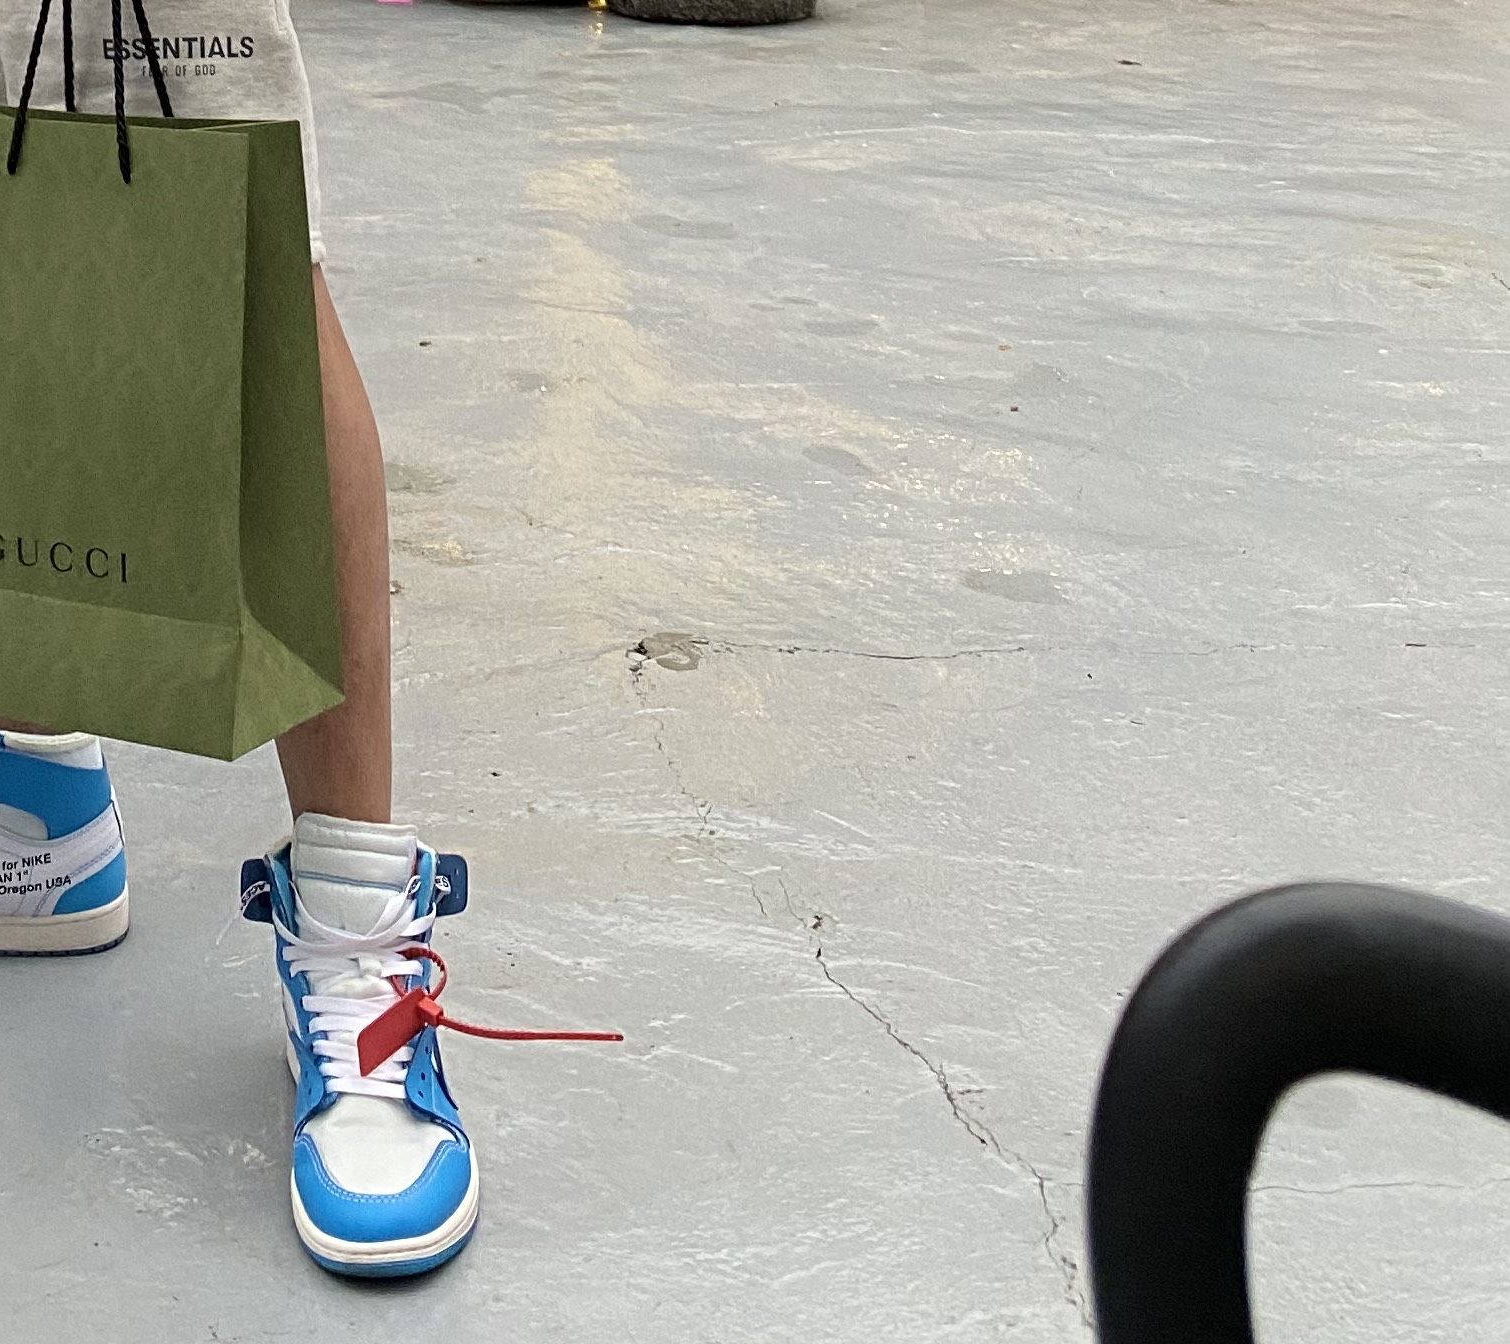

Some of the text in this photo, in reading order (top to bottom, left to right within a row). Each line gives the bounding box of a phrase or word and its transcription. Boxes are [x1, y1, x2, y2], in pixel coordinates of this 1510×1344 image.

[175, 64, 188, 77] OF
[194, 63, 217, 76] GOD
[2, 860, 19, 871] for
[21, 853, 52, 868] NIKE
[45, 874, 72, 889] USA
